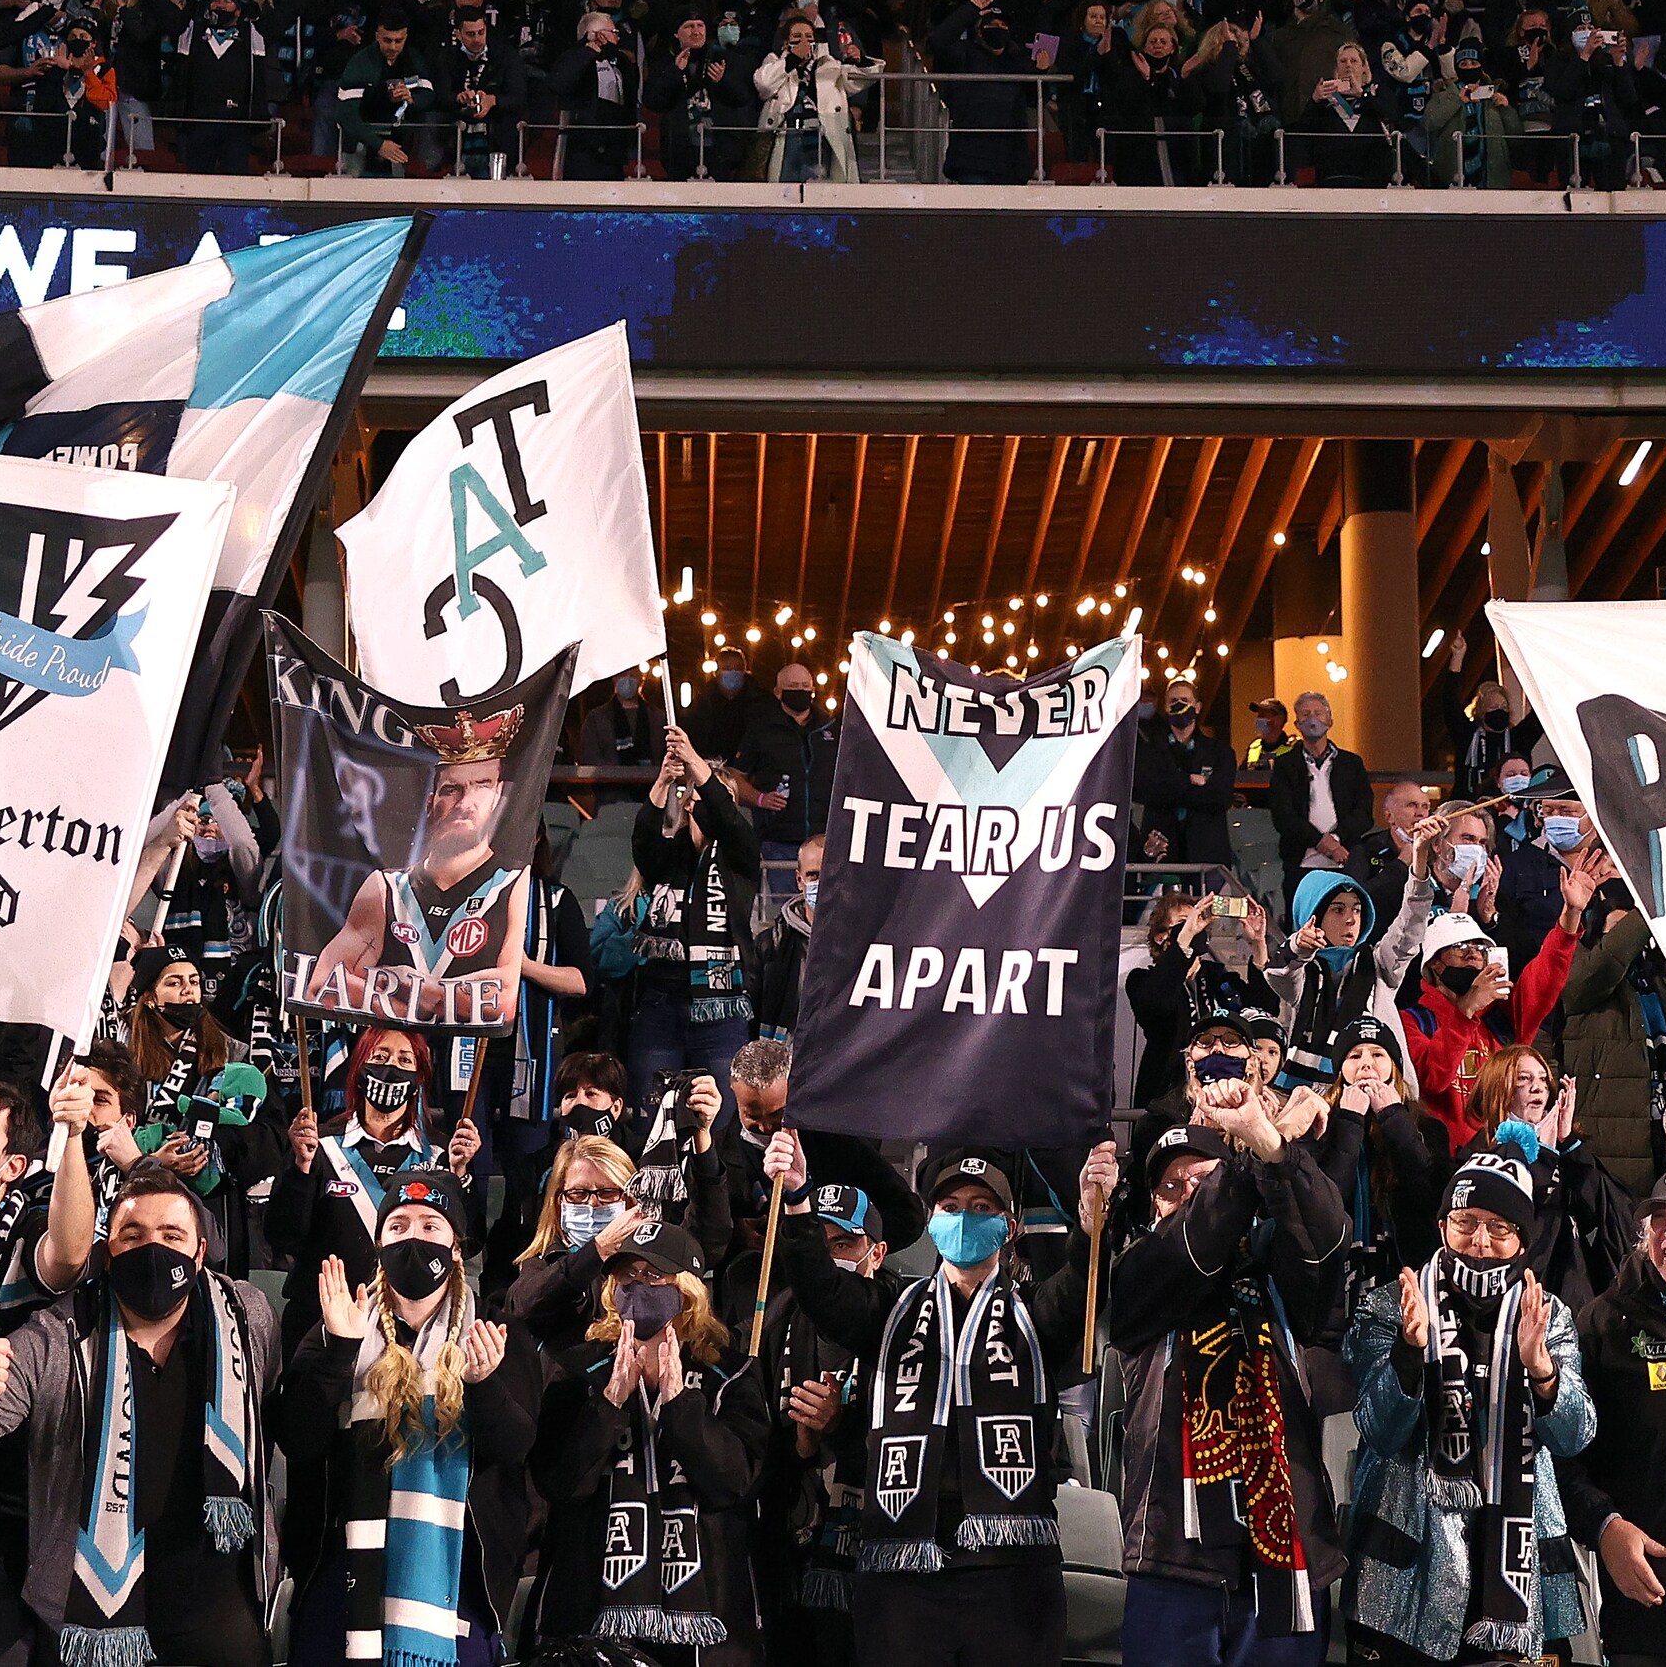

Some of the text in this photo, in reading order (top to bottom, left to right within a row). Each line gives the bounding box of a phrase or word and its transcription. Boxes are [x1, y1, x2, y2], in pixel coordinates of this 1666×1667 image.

[41, 643, 110, 690] Proud
[267, 653, 416, 749] KING
[889, 663, 1110, 737] NEVER
[842, 796, 1118, 876] TEAR US
[428, 905, 451, 917] ISC
[392, 927, 416, 940] AFL
[450, 920, 485, 952] MG
[848, 944, 1079, 1017] APART
[328, 1180, 356, 1195] AFL
[372, 1165, 396, 1175] ISC
